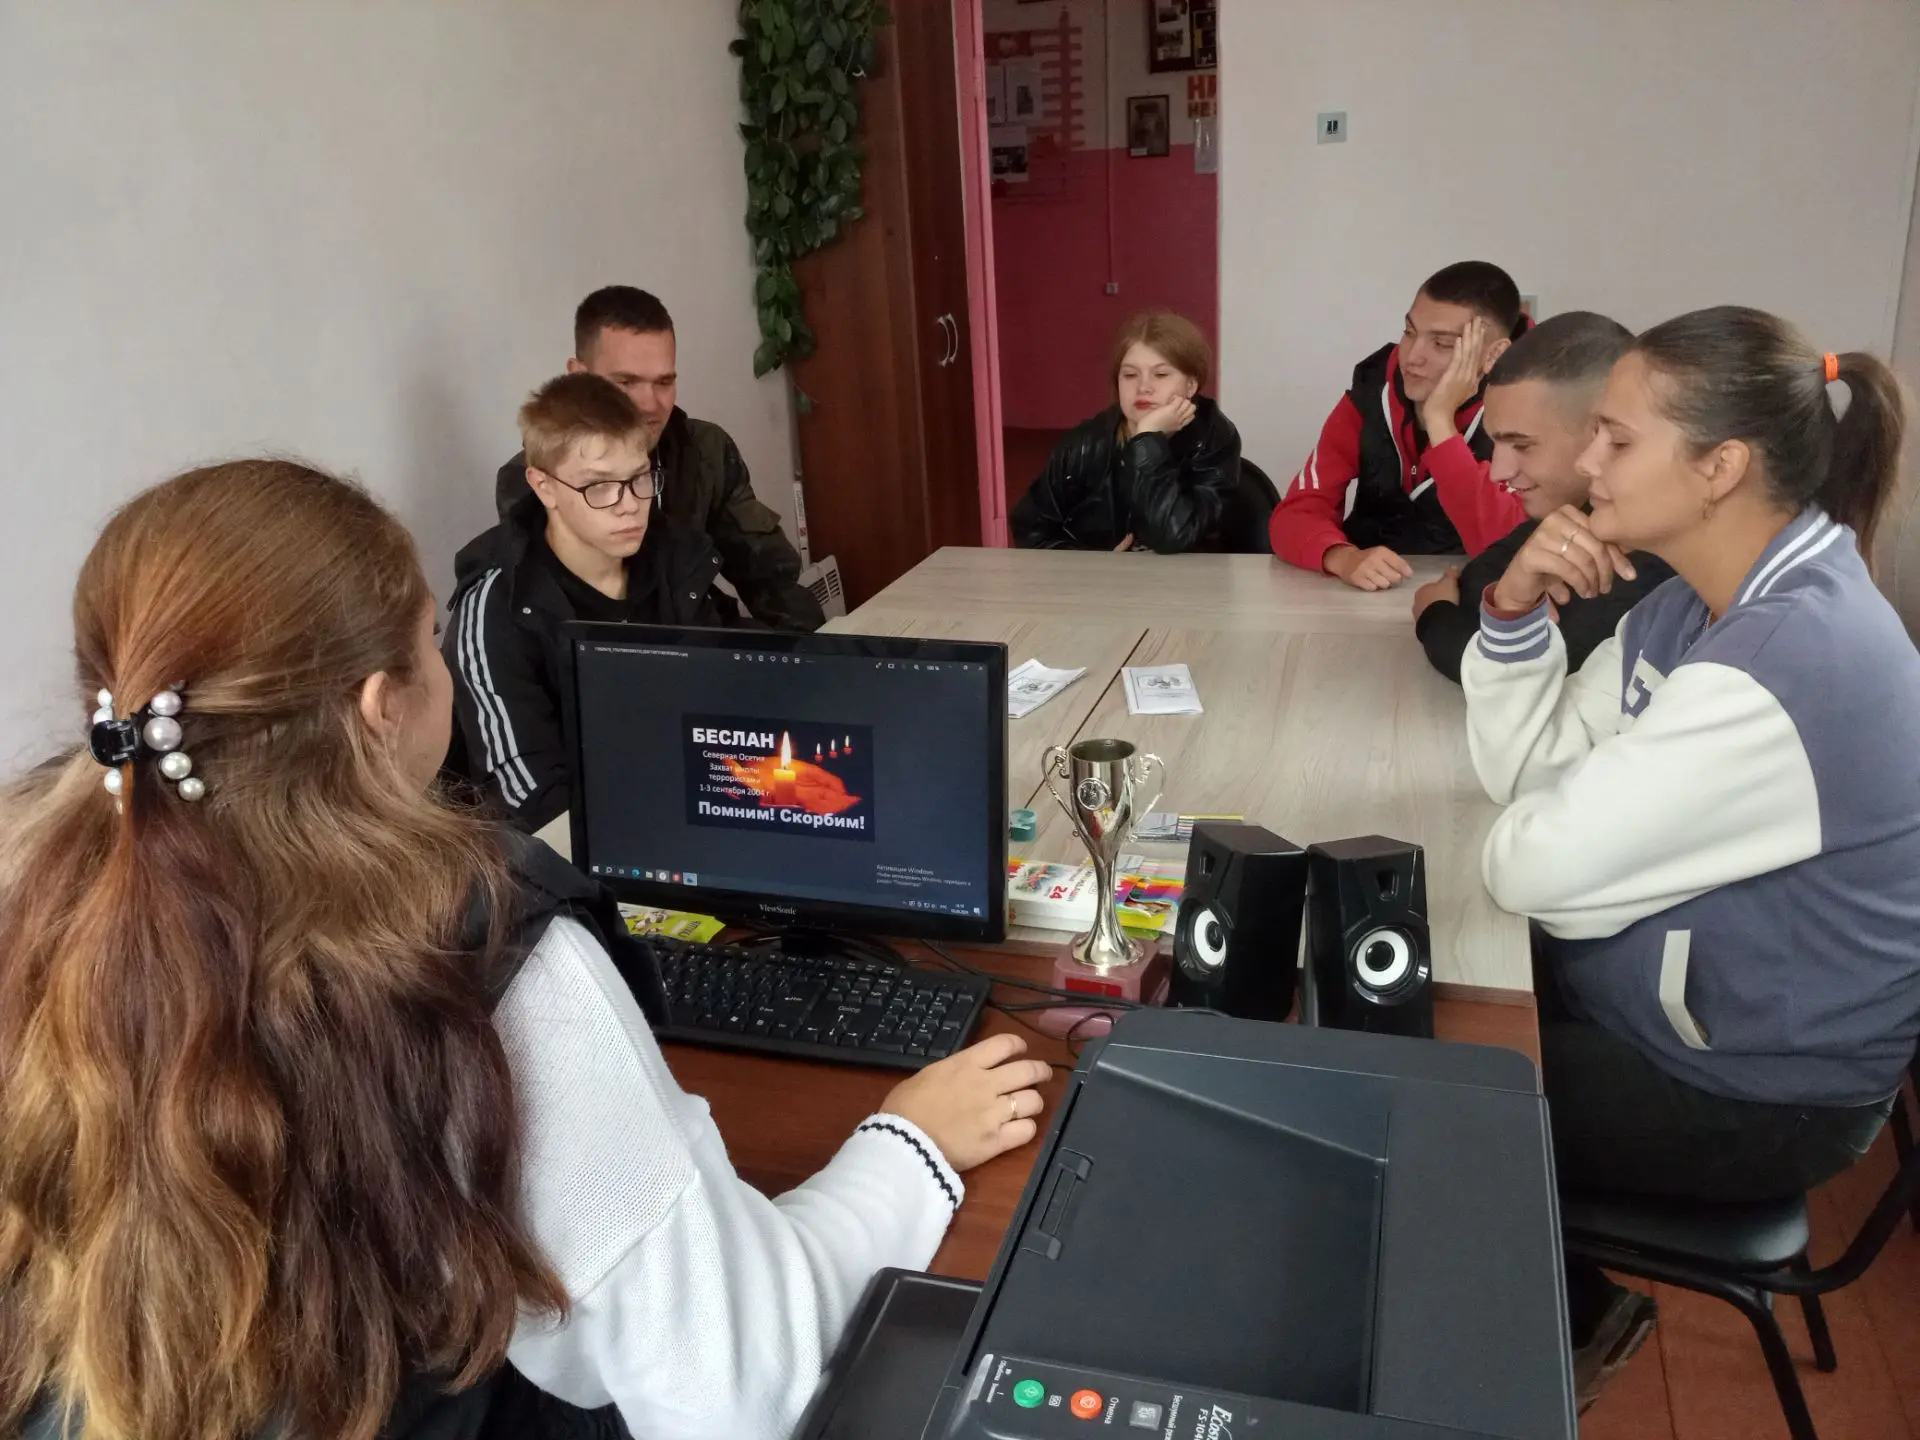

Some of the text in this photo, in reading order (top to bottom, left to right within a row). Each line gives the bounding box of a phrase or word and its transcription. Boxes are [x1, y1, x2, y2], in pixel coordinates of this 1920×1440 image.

[692, 727, 775, 749] БЕСЛАН
[702, 750, 765, 762] Северная Осетия
[709, 763, 733, 772] Захват
[708, 773, 761, 784] террористами
[700, 784, 711, 792] 1-3
[712, 785, 746, 795] сентября
[747, 788, 765, 797] 2004
[698, 801, 865, 830] Помним! Скорбим!
[1049, 885, 1069, 899] 24
[759, 903, 797, 915] ViewSonic
[1103, 1397, 1119, 1425] Отмена
[1167, 1394, 1183, 1429] Бесшумный
[1194, 1408, 1208, 1440] FS-104
